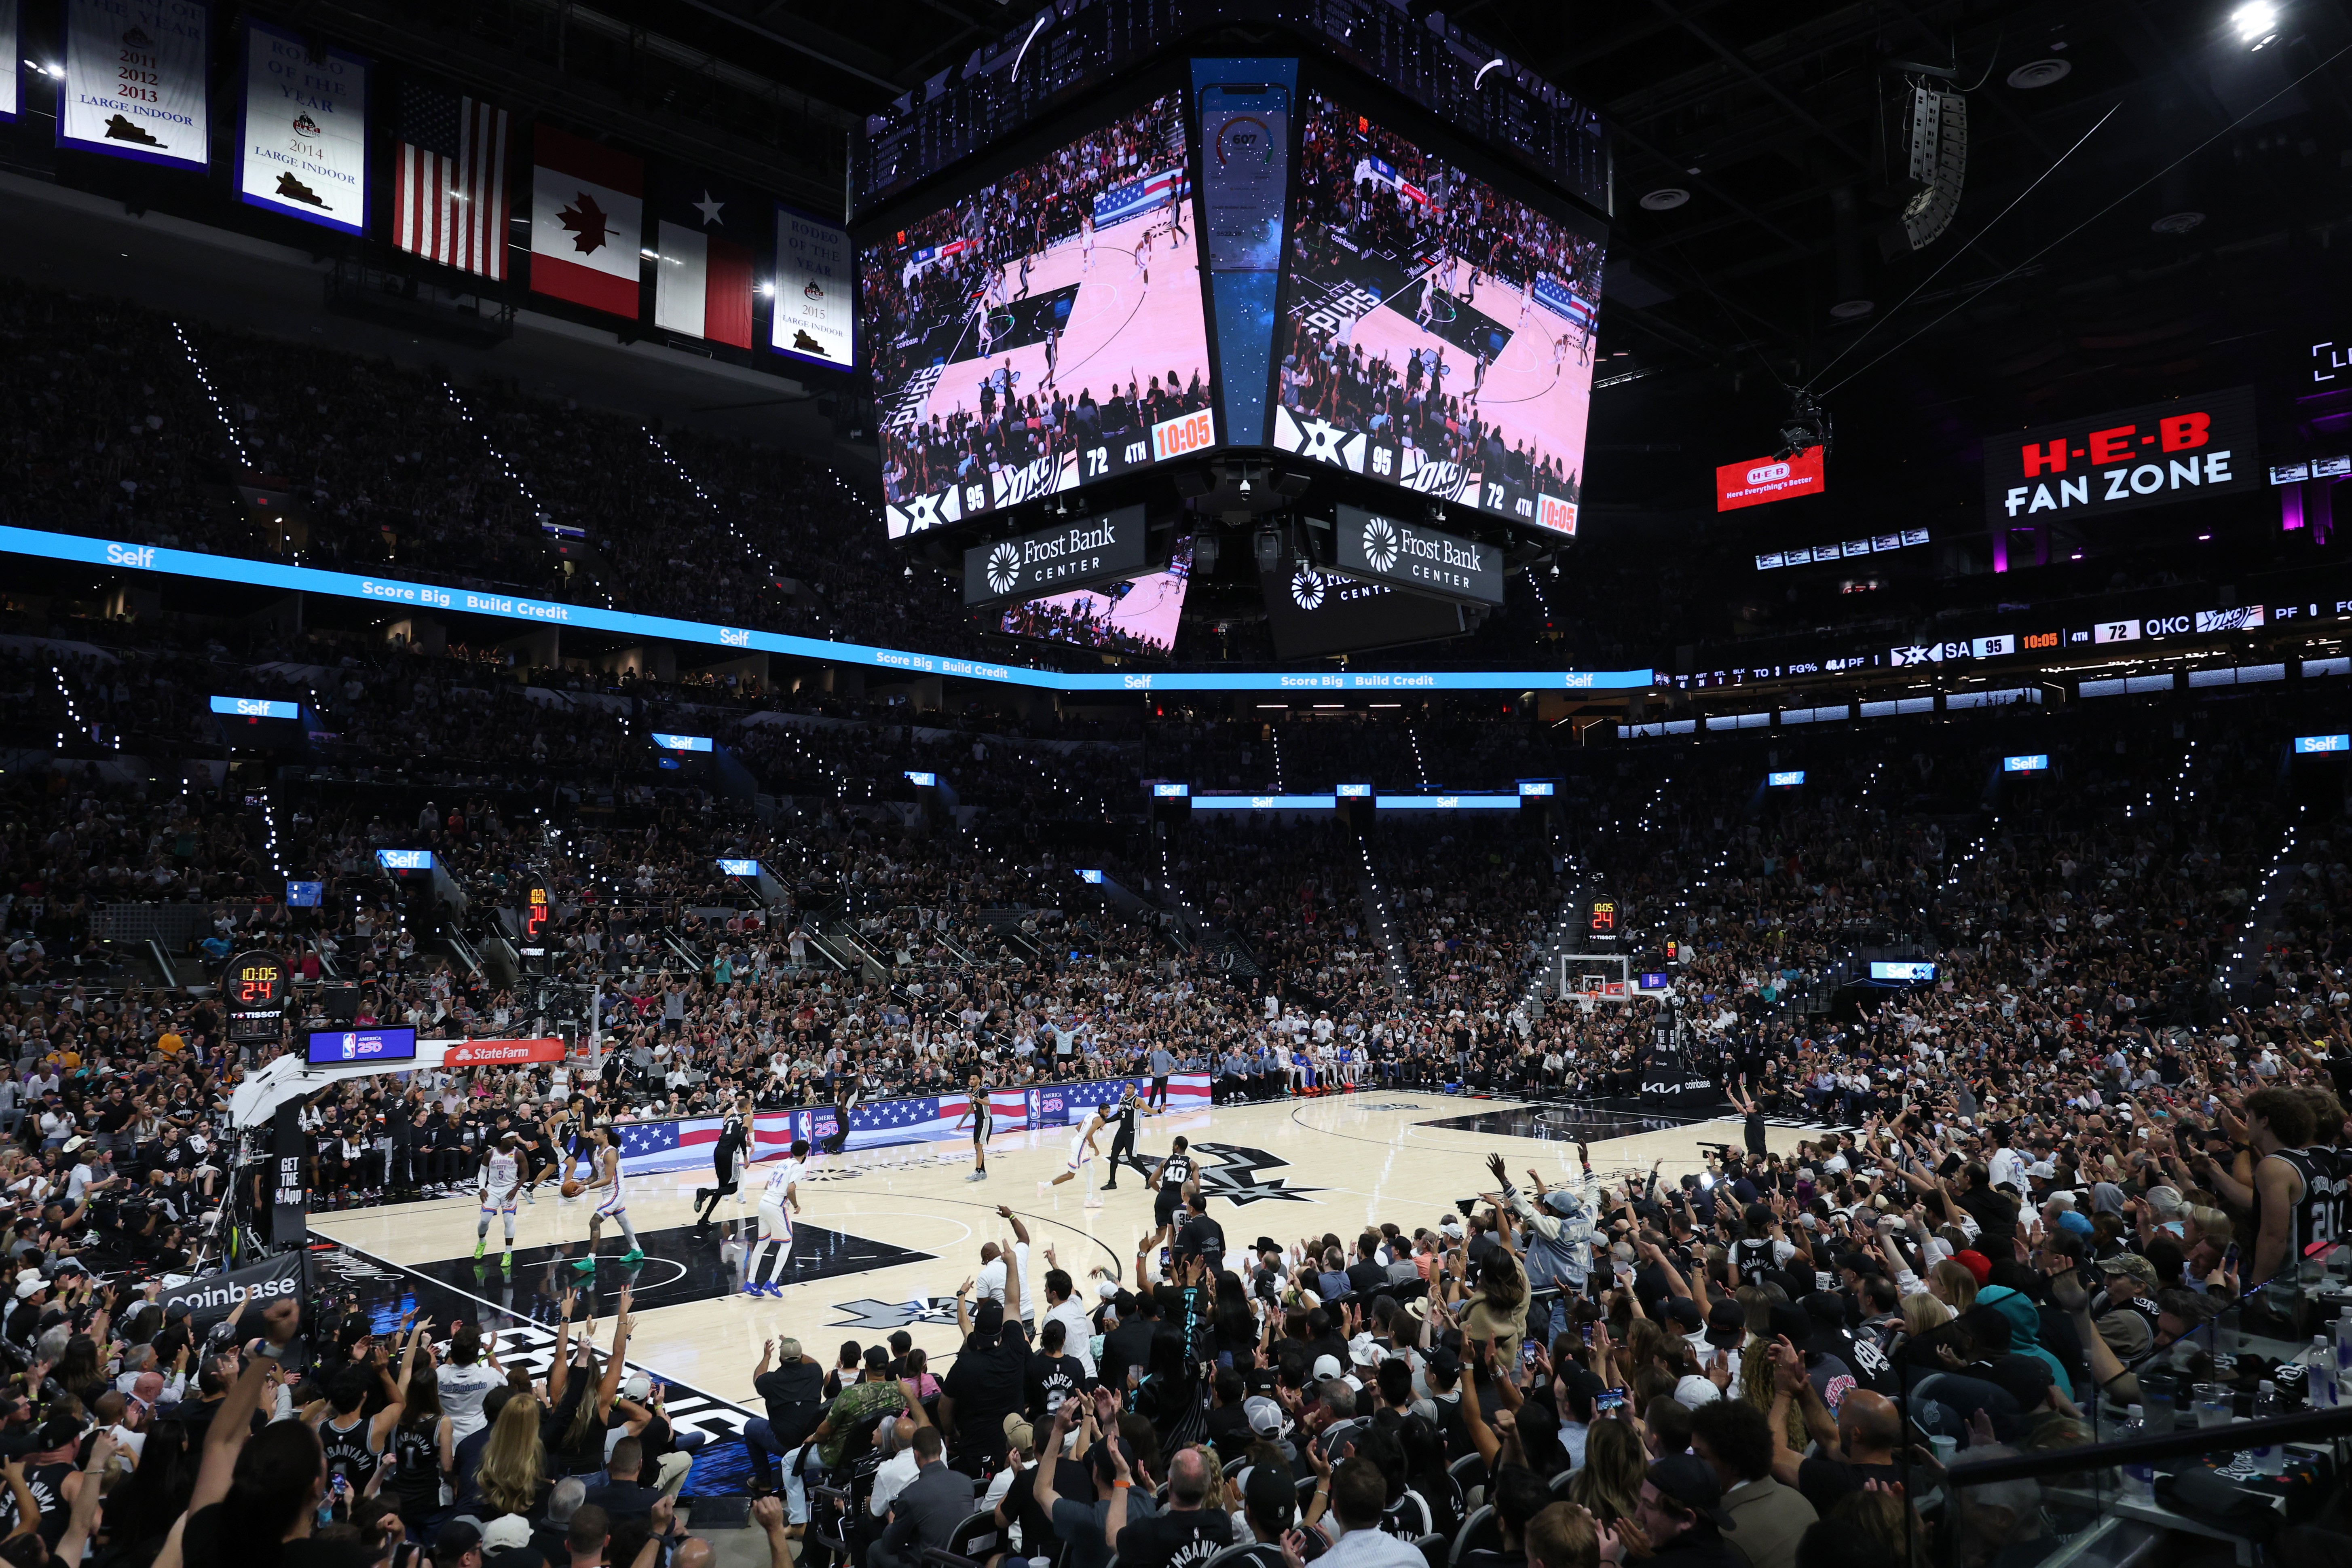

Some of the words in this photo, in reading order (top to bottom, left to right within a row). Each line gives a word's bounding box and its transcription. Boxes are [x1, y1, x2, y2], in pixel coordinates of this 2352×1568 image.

[138, 10, 201, 39] YEAR
[120, 50, 156, 68] 2011
[1052, 43, 1069, 59] DORT
[1052, 46, 1082, 68] WILLIAMS
[118, 66, 158, 86] 2012
[268, 61, 296, 78] OF
[304, 75, 347, 96] THE
[1052, 70, 1064, 81] JOE
[118, 84, 157, 102] 2013
[280, 84, 333, 113] YEAR
[80, 94, 129, 112] LARGE
[133, 105, 193, 126] INDOOR
[1232, 134, 1257, 144] 607
[290, 139, 323, 160] 2014
[255, 146, 298, 167] LARGE
[302, 161, 355, 185] INDOOR
[1119, 205, 1160, 223] Google
[792, 220, 838, 244] RODEO
[789, 238, 807, 251] OF
[811, 245, 840, 262] THE
[1331, 234, 1358, 253] coinbase
[797, 257, 831, 277] YEAR
[802, 305, 825, 319] 2015
[1550, 307, 1578, 325] Google
[783, 315, 809, 328] LARGE
[811, 319, 843, 337] INDOOR
[896, 337, 919, 349] coinbase
[2022, 412, 2210, 478] H-E-B
[967, 484, 985, 511] 95
[1086, 447, 1108, 476] 72
[1124, 441, 1146, 465] 4TH
[1157, 415, 1210, 456] 10:05
[1372, 446, 1392, 476] 95
[1487, 483, 1503, 510] 72
[1515, 498, 1532, 518] 4TH
[1541, 499, 1574, 532] 10:05
[1726, 491, 1743, 499] Here
[1745, 481, 1788, 496] Everything's
[1789, 476, 1812, 486] Better
[2005, 475, 2088, 517] FAN
[2104, 450, 2232, 501] ZONE
[1024, 535, 1066, 564] Frost
[1069, 518, 1116, 554] Bank
[1401, 529, 1440, 561] Frost
[1443, 540, 1482, 572] Bank
[1035, 557, 1099, 581] CENTER
[1413, 564, 1469, 588] CENTER
[362, 581, 414, 600] Score
[467, 595, 511, 613] Build
[1340, 585, 1397, 600] CENTE
[1753, 668, 1769, 678] TO
[1775, 666, 1779, 676] 3
[1789, 663, 1817, 674] FG%
[1826, 659, 1845, 671] 46.4
[1848, 658, 1864, 668] PF
[1874, 655, 1878, 665] 1
[1946, 642, 1970, 658] SA
[1986, 640, 2002, 653] 95
[2024, 633, 2058, 649] 10:05
[2071, 632, 2088, 642] 4TH
[2109, 625, 2127, 640] 72
[2146, 616, 2189, 635] OKC
[2276, 607, 2297, 619] PF
[2310, 604, 2317, 616] 0
[877, 652, 910, 666] Score
[942, 661, 971, 674] Build
[1281, 676, 1317, 686] Score
[1355, 676, 1389, 686] Build
[1594, 903, 1613, 912] 10:05
[528, 906, 547, 934] 24
[1593, 913, 1612, 928] 24
[1667, 949, 1674, 957] 24
[243, 967, 277, 981] 10:05
[242, 982, 271, 1000] 24
[357, 1041, 382, 1053] 250
[1685, 1079, 1710, 1090] coinbase
[1042, 1099, 1063, 1112] 250
[726, 1122, 733, 1135] 1
[815, 1121, 839, 1137] 250
[281, 1157, 299, 1172] GET
[851, 1157, 933, 1171] Frost
[935, 1149, 1013, 1160] Bank
[281, 1172, 298, 1187] THE
[499, 1171, 503, 1179] 5
[769, 1172, 784, 1187] 34
[1165, 1166, 1187, 1182] 40
[284, 1188, 301, 1205] App
[1752, 1271, 1762, 1286] 1
[453, 1382, 487, 1391] Antonio
[1042, 1373, 1072, 1390] HARPER
[406, 1446, 415, 1469] 1
